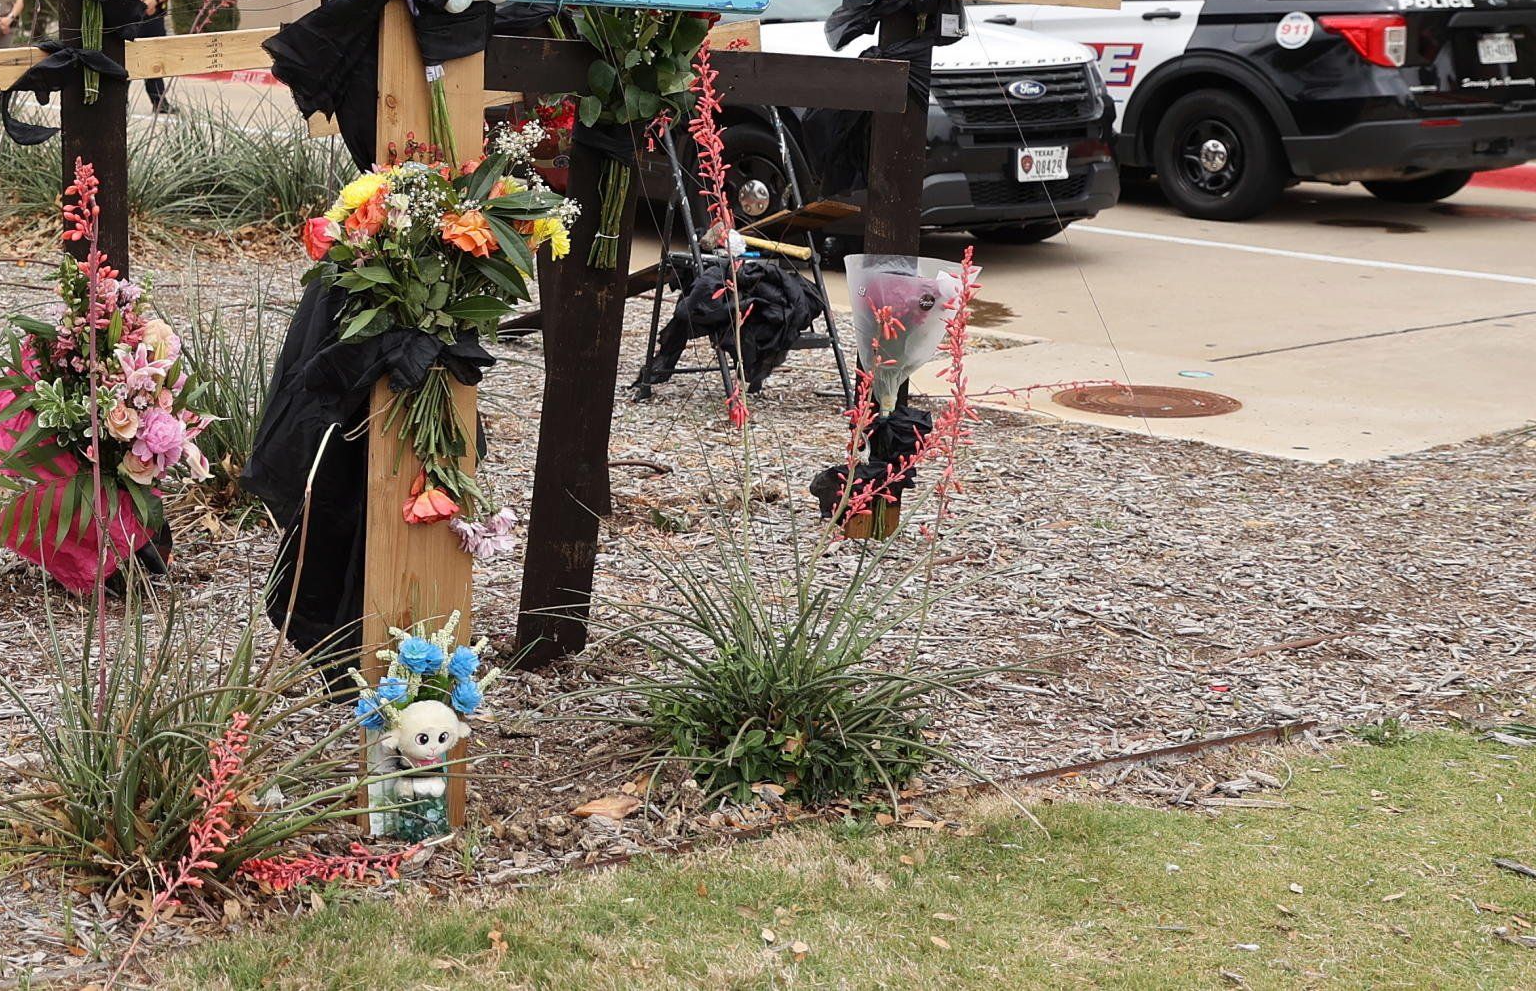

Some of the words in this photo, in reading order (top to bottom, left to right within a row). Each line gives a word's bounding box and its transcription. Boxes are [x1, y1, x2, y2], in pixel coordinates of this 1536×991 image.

[1281, 24, 1310, 35] 911
[932, 56, 1083, 68] NTERCEPTOR
[1019, 82, 1041, 95] Ford
